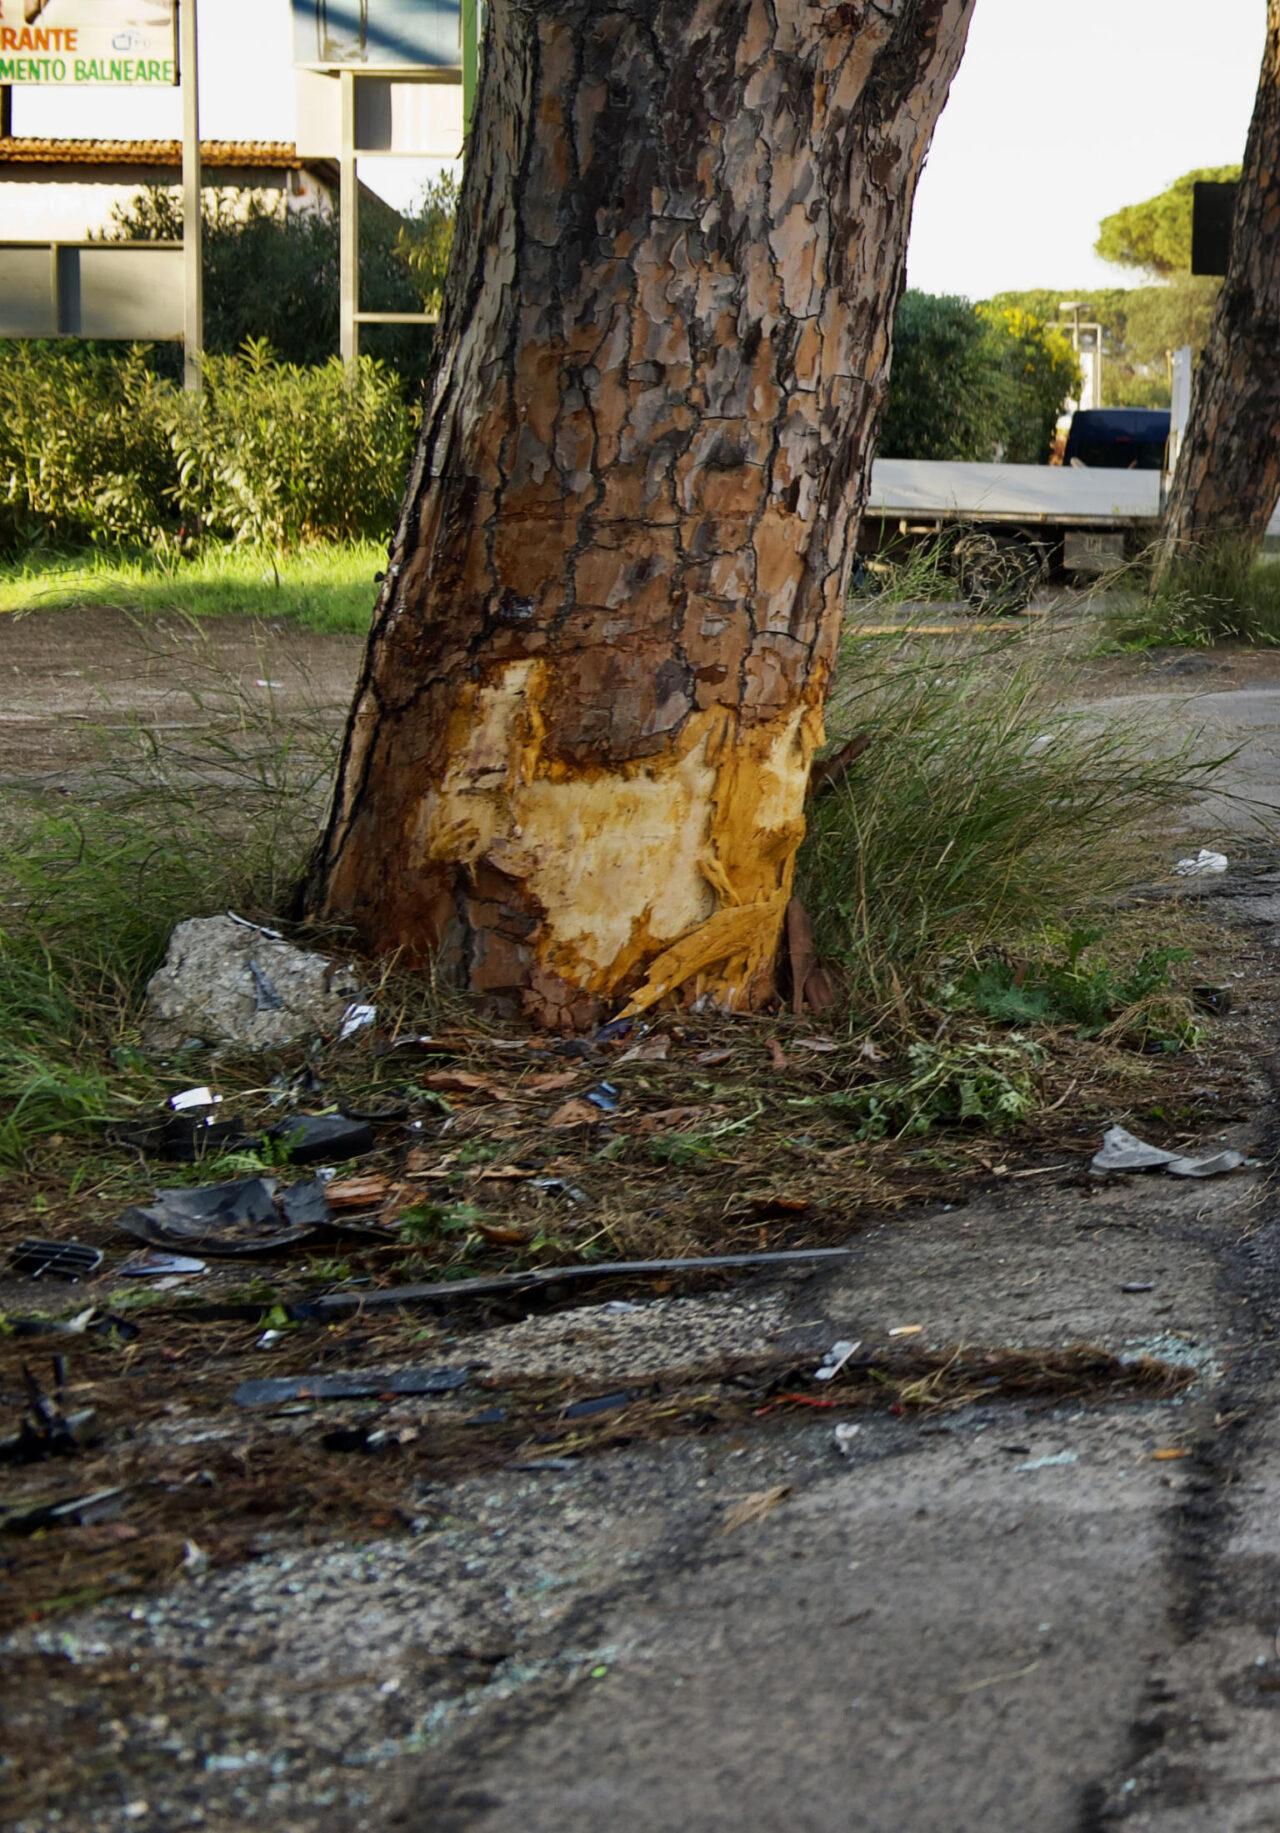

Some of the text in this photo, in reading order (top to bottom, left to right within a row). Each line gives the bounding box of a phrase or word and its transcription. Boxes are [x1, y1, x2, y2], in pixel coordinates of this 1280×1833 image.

[0, 27, 78, 51] RANTE
[0, 58, 173, 82] MENTO BALNEARE
